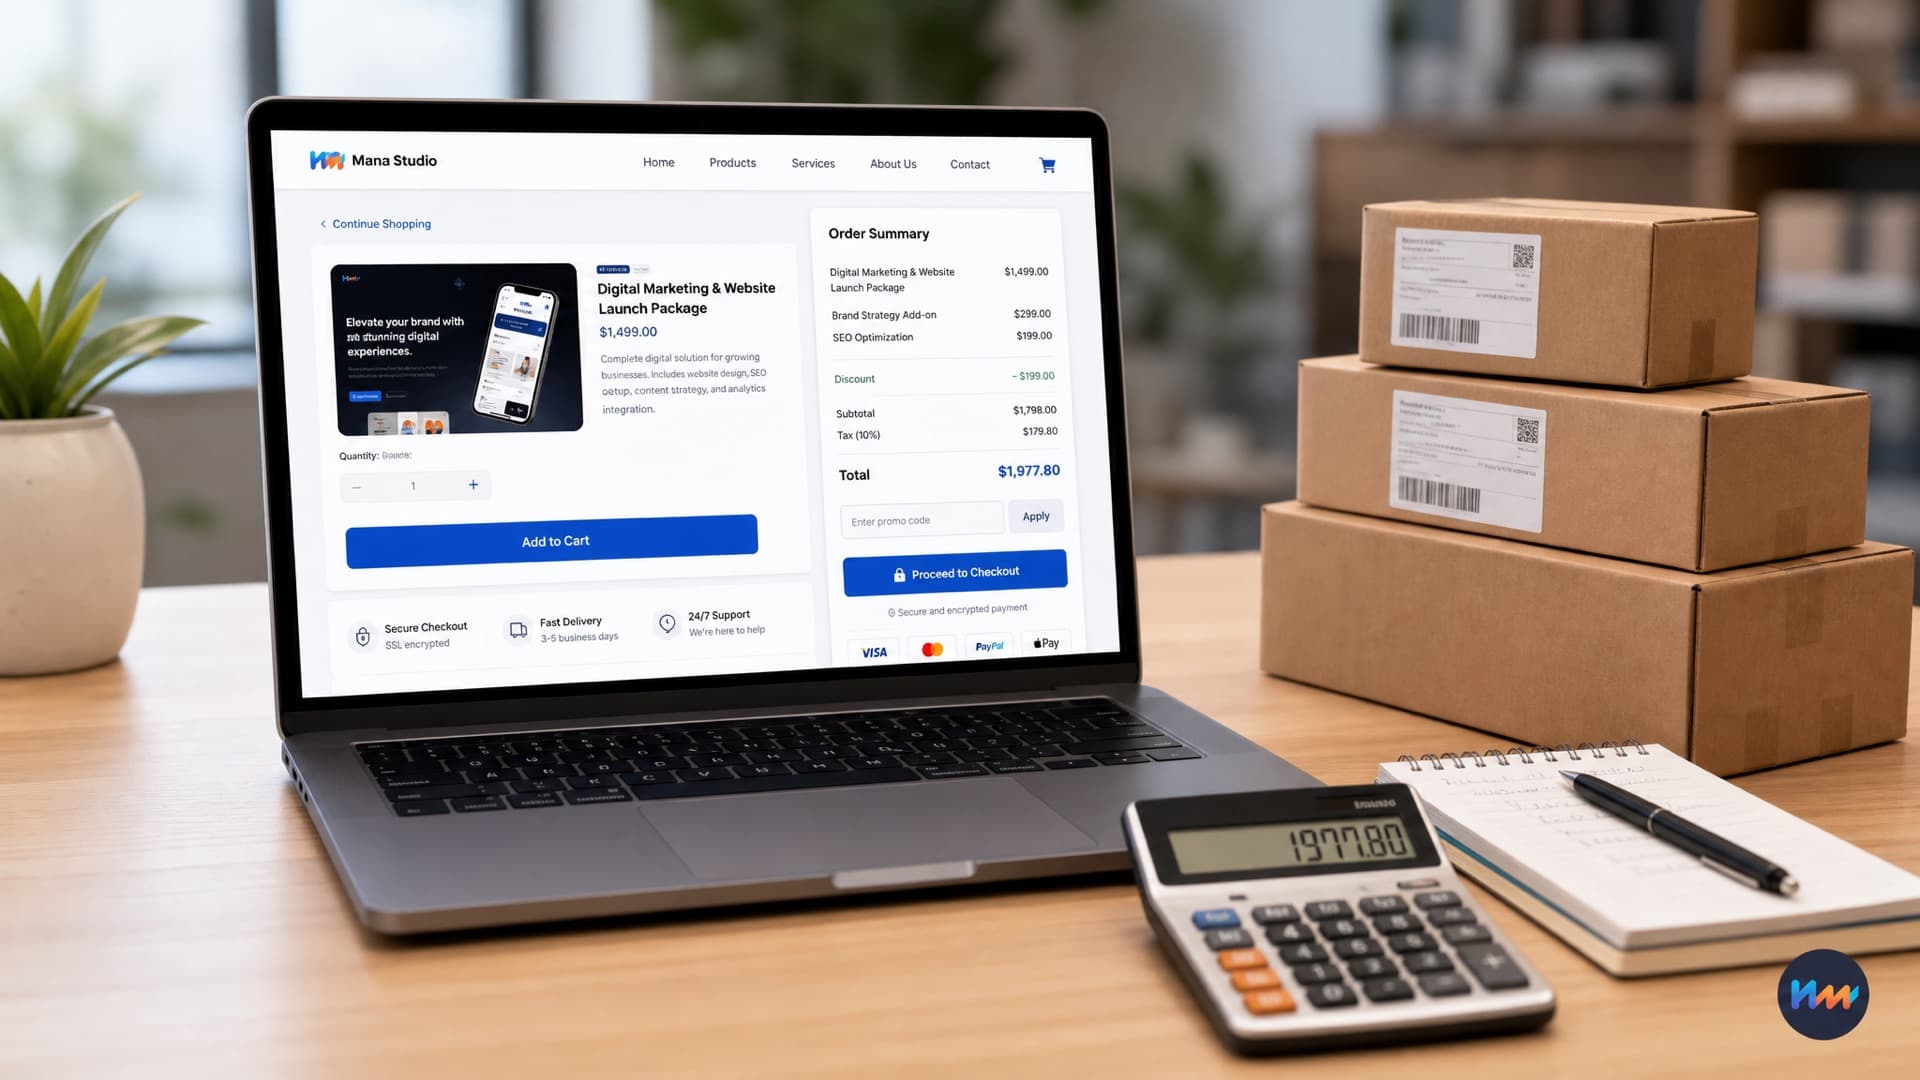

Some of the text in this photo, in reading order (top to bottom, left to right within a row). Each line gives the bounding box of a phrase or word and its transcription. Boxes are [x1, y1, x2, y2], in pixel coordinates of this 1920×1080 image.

[353, 155, 390, 166] Mana
[394, 155, 437, 166] Studio
[644, 157, 675, 167] Home
[710, 158, 756, 167] Products
[792, 158, 835, 168] Services
[871, 159, 917, 168] About Us
[951, 160, 990, 169] Contact
[333, 219, 431, 230] Continue Shopping
[829, 228, 929, 241] Order Summary
[830, 268, 955, 278] Digital Marketing & Website
[1005, 267, 1048, 277] $1,499.00
[598, 282, 775, 297] Digital Marketing & Website
[831, 283, 905, 294] Launch Package
[599, 302, 707, 316] Launch Package
[1014, 309, 1051, 319] $299.00
[832, 310, 937, 321] Brand Strategy Add-on
[346, 316, 464, 328] Elevate your brand with
[408, 331, 439, 343] digital
[600, 326, 657, 339] $1,499.00
[1017, 331, 1052, 340] $199.00
[833, 333, 913, 343] SEO Optimization
[348, 347, 412, 358] experiences.
[601, 353, 760, 364] Complete digital solution for growing
[601, 371, 649, 379] businesses.
[651, 370, 685, 378] Includes
[687, 369, 718, 377] website
[720, 369, 749, 379] design,
[835, 375, 875, 383] Discount
[1020, 371, 1055, 381] $199.00
[711, 385, 726, 393] and
[728, 384, 766, 394] analytics
[603, 404, 655, 416] integration.
[836, 409, 875, 418] Subtotal
[1013, 406, 1057, 415] $1,798.00
[837, 431, 880, 440] Tax (10%)
[1023, 427, 1058, 436] $179.80
[339, 452, 379, 461] Quantity:
[839, 469, 870, 480] Total
[999, 464, 1060, 478] $1,977.80
[412, 482, 415, 490] 1
[852, 516, 930, 528] Enter promo code
[1023, 512, 1049, 522] Apply
[522, 536, 590, 547] Add to Cart
[912, 567, 1019, 579] Proceed to Checkout
[898, 604, 1027, 616] Secure and encrypted payment
[689, 611, 750, 621] 24/7 Support
[540, 617, 602, 627] Fast Delivery
[385, 622, 467, 633] Secure Checkout
[689, 628, 713, 636] We're
[715, 627, 733, 635] here
[747, 625, 765, 635] help
[541, 632, 619, 643] 3-5 business days
[386, 638, 449, 650] SSL encrypted
[976, 642, 1003, 652] PayPal
[863, 648, 887, 658] VISA
[1290, 824, 1407, 862] 1977.80
